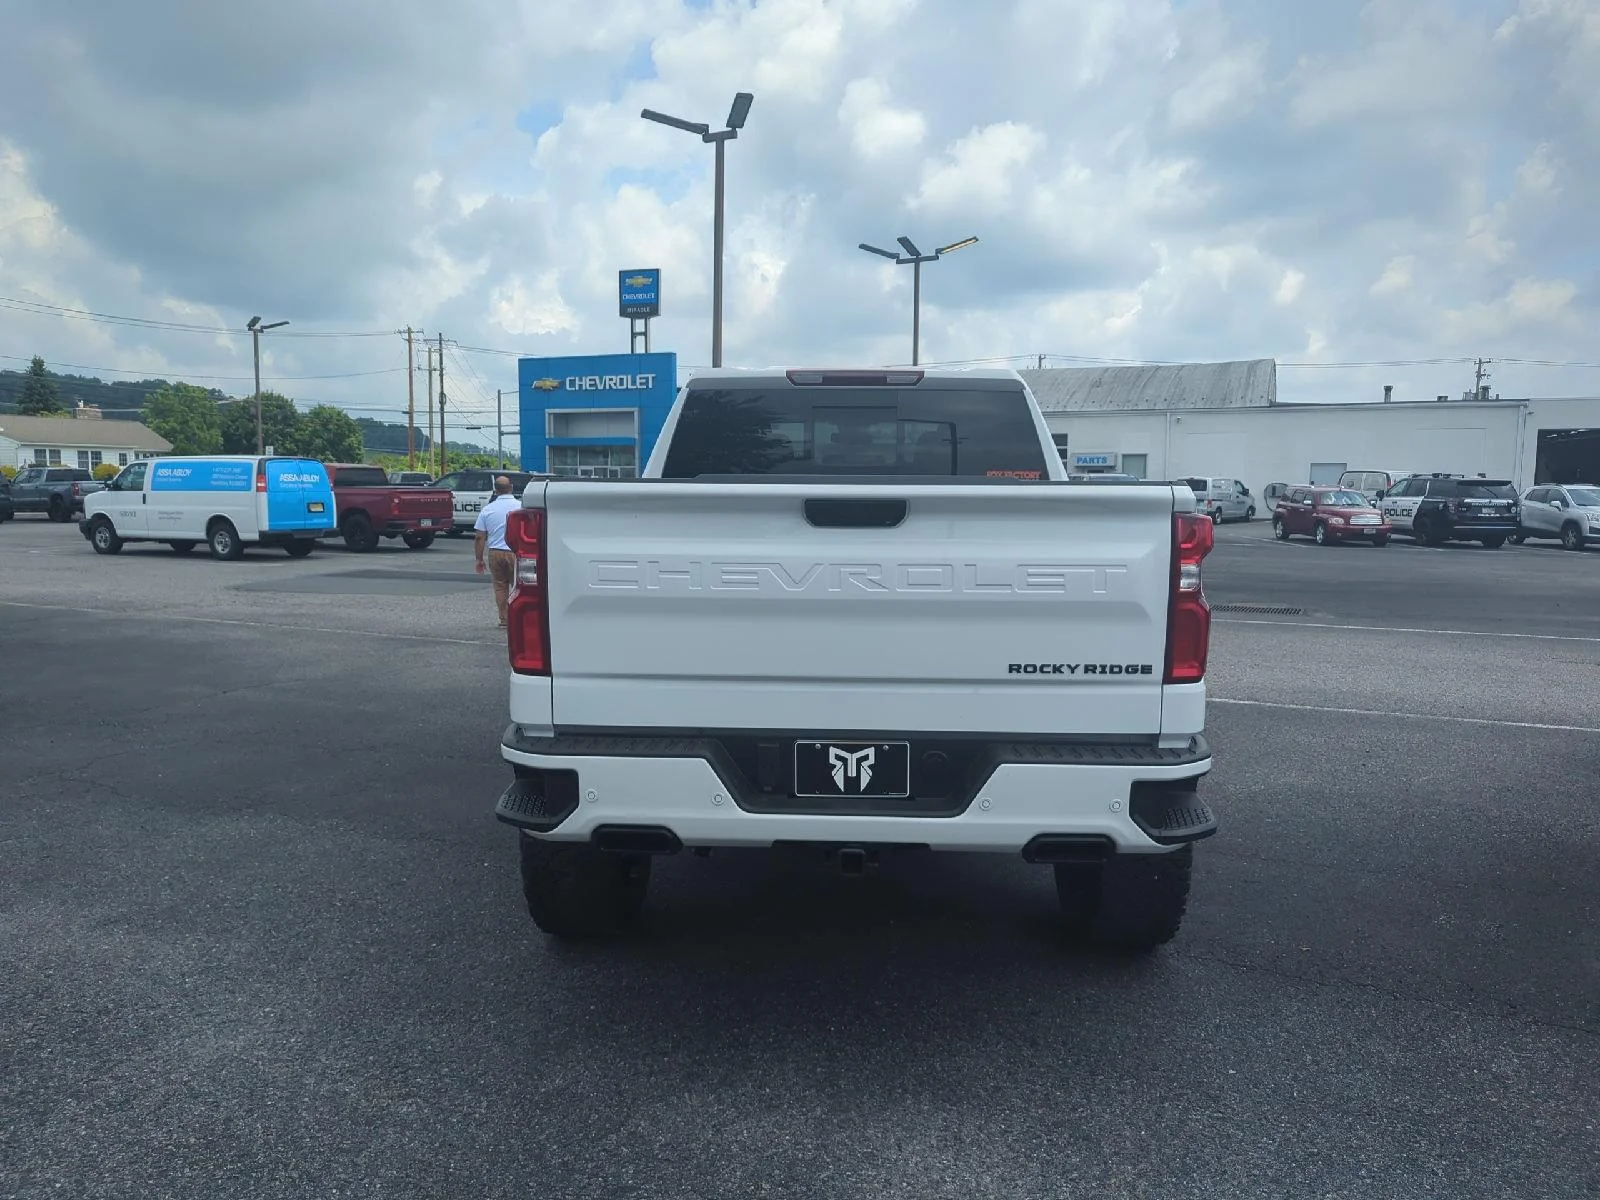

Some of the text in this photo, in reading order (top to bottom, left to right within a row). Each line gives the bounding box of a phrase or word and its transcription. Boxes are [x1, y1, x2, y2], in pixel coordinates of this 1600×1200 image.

[565, 373, 656, 391] CHEVROLET
[1076, 456, 1107, 465] PARTS
[454, 503, 481, 512] LICE
[1384, 508, 1413, 518] POLICE
[588, 560, 1128, 594] CHEVROLET
[1008, 663, 1153, 675] ROCKY RIDGE
